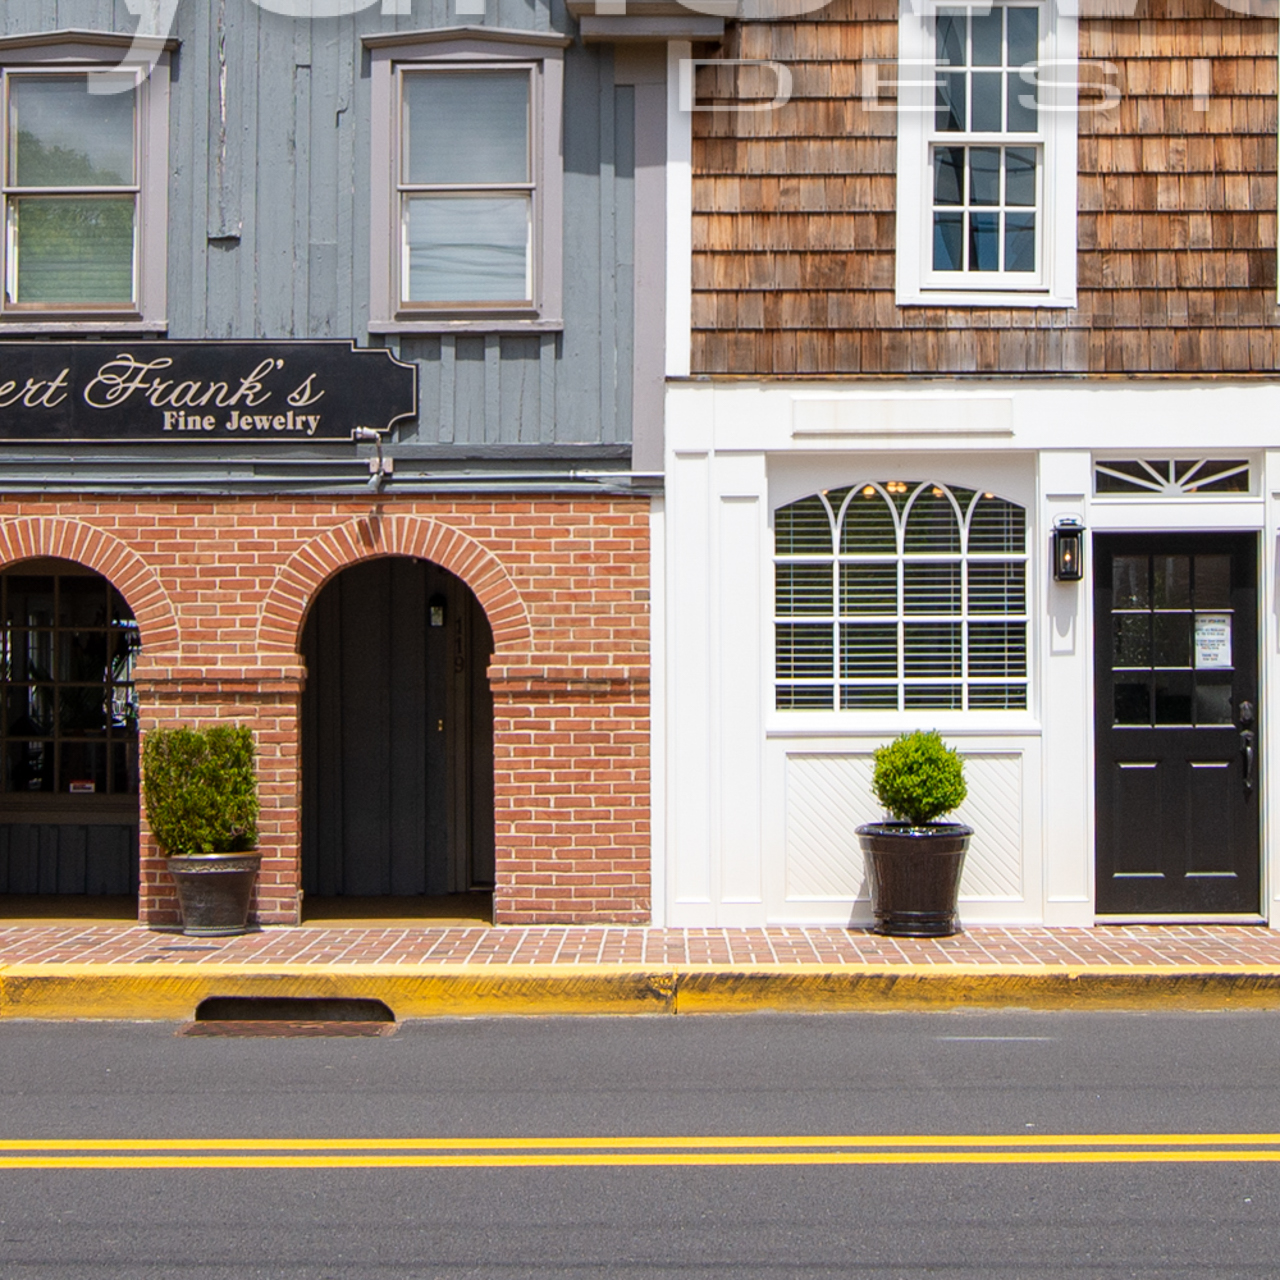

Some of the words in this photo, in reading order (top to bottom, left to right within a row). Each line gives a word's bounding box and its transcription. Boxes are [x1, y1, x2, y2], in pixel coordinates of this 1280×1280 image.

[83, 353, 325, 408] Frank's
[162, 411, 216, 431] Fine
[225, 410, 321, 436] Jewelry
[454, 617, 464, 673] 119
